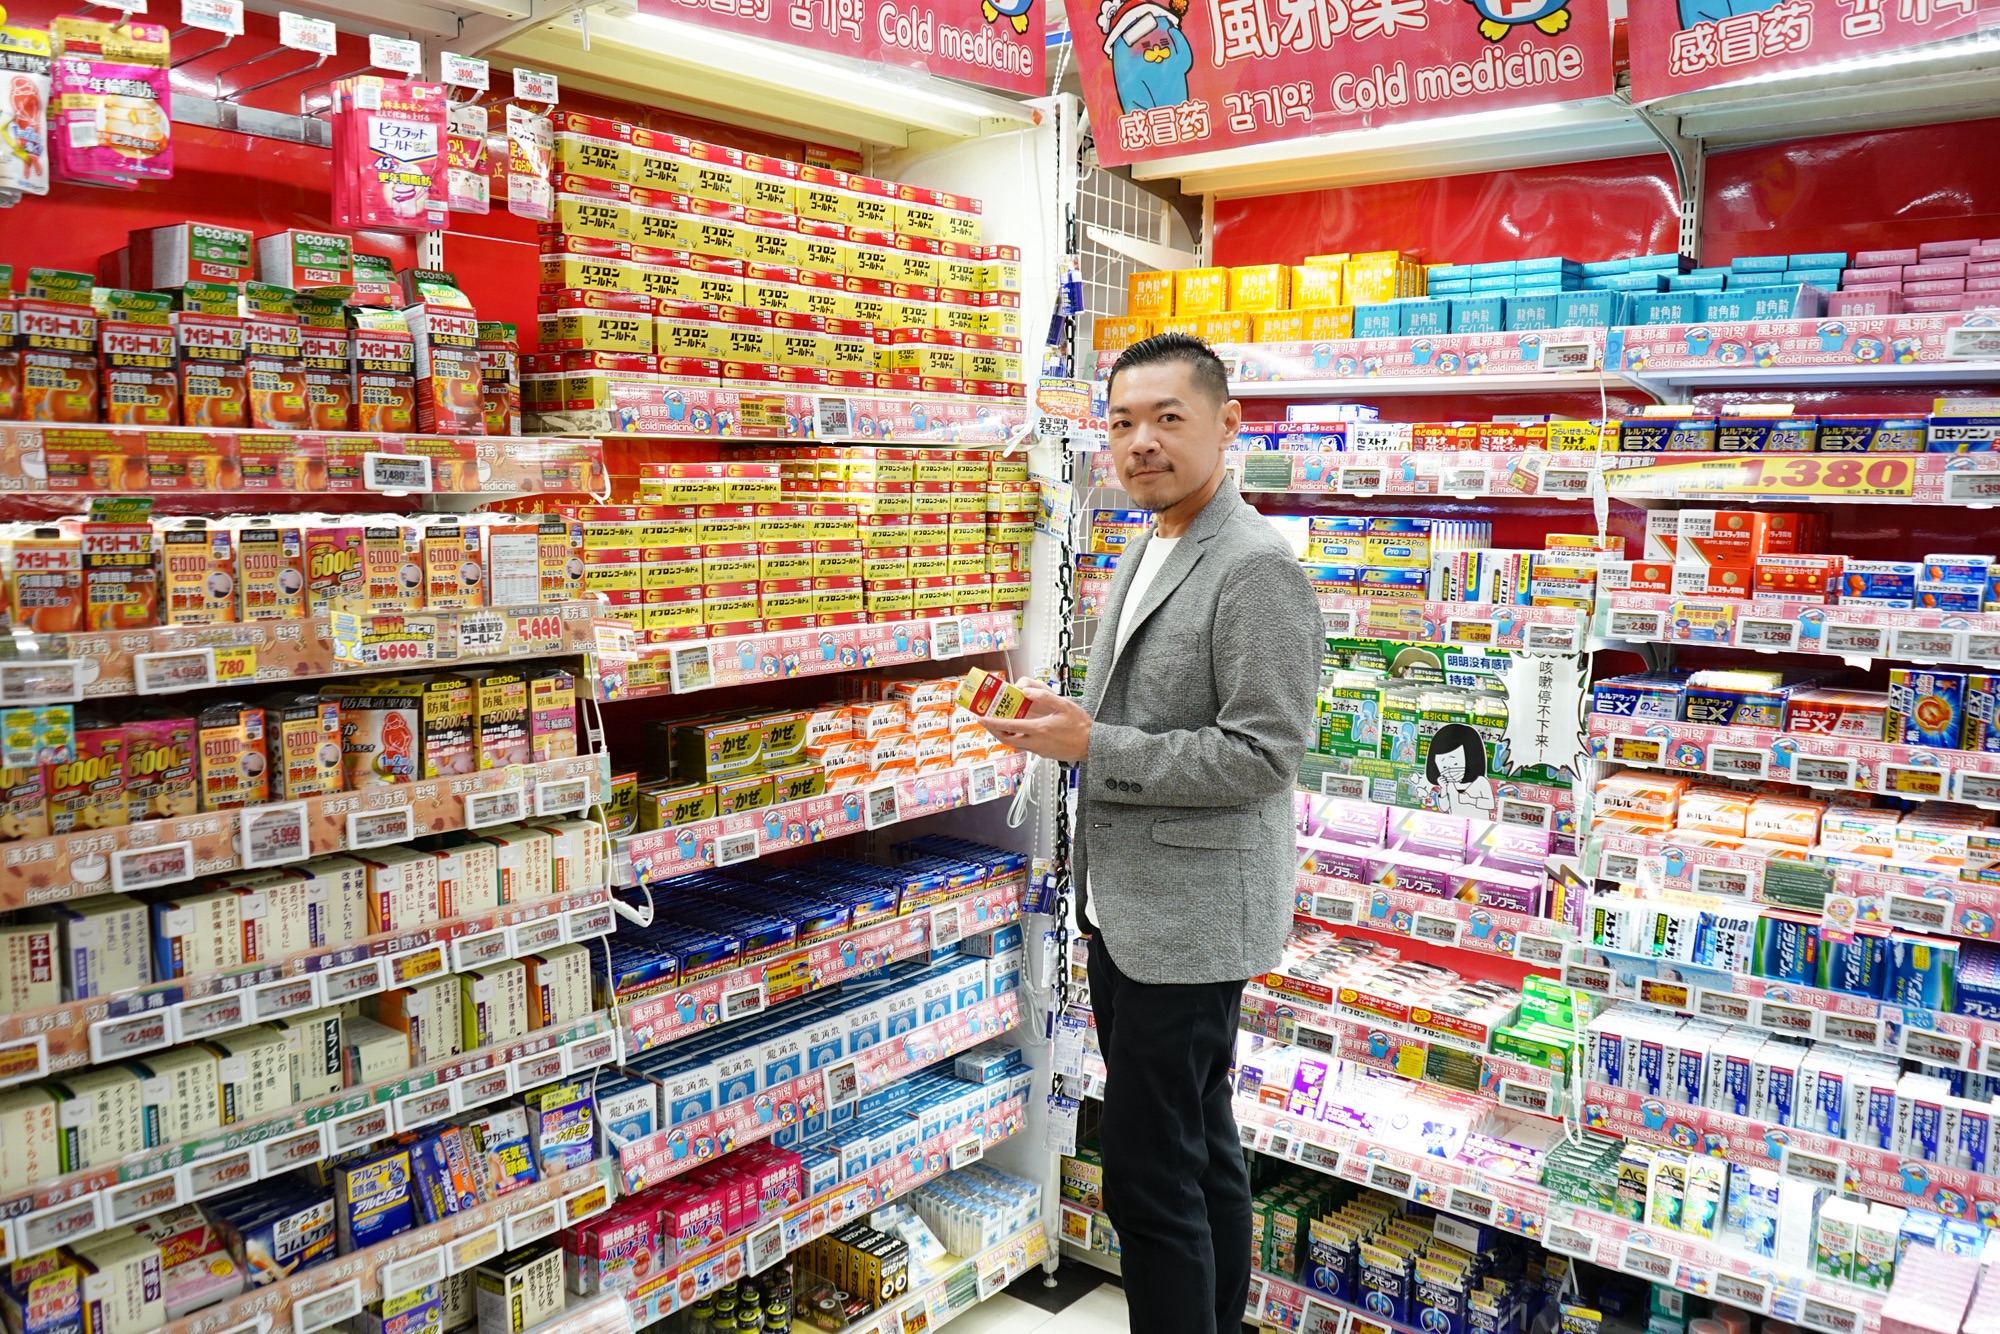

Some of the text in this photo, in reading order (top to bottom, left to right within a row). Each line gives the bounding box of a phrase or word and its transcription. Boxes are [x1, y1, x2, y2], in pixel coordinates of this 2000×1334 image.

[877, 4, 1034, 77] Cold medicine
[1669, 3, 1814, 77] 感冒药
[1331, 40, 1584, 114] Cold medicine
[1223, 81, 1315, 135] 감기약
[379, 122, 428, 140] ビスラット
[1118, 101, 1212, 151] 感冒药
[582, 158, 616, 171] ゴールドA
[643, 158, 680, 173] パブロン
[646, 169, 677, 183] ゴールドA
[809, 191, 839, 204] パブロン
[810, 202, 837, 214] ゴールドA
[580, 217, 616, 231] ゴールドA
[193, 226, 247, 244] ecoボトル
[295, 233, 346, 248] ecoボトル
[1568, 302, 1599, 318] 龍角散
[25, 314, 94, 337] ナイシトールZ
[430, 317, 475, 335] ナイシトールZ
[598, 319, 639, 332] パブロン
[1846, 319, 1886, 335] 감기약
[1896, 316, 1945, 332] 風邪薬
[184, 327, 242, 347] ナイシトールZ
[246, 323, 298, 345] ナイシトールZ
[600, 330, 636, 343] ゴールドA
[108, 334, 171, 354] ナイシトールZ
[1366, 340, 1398, 352] 風邪薬
[1563, 353, 1588, 363] 598
[1648, 355, 1720, 368] Cold medicine
[1078, 418, 1109, 431] 399
[1278, 423, 1335, 433] のどの痛みなどに
[1551, 428, 1597, 436] つらいせき、たん
[1424, 437, 1447, 446] ストナ
[1623, 435, 1663, 450] EX
[1719, 435, 1760, 450] EX
[1821, 435, 1865, 450] EX
[1358, 477, 1379, 486] 1,490
[1739, 459, 1908, 488] 1,380
[1310, 537, 1360, 546] パブロンエースPro
[1369, 538, 1425, 547] パブロンエースPro
[369, 584, 397, 599] 脂肪
[431, 582, 457, 598] 脂肪
[172, 593, 204, 612] 脂肪
[246, 590, 277, 607] 脂肪
[517, 614, 563, 642] 5,999
[1630, 620, 1658, 633] 2,490
[783, 636, 809, 649] 風邪薬
[1761, 629, 1792, 643] 1,290
[1849, 636, 1880, 648] 1,990
[753, 638, 777, 652] 감기약
[1920, 641, 1953, 652] 1,290
[1449, 674, 1476, 687] 持续
[1335, 689, 1361, 699] 長引く咳
[1535, 660, 1554, 762] 咳嗽停不下来!
[1596, 699, 1633, 714] EX
[1687, 706, 1729, 721] EX
[1791, 709, 1837, 720] ルルアタック
[771, 723, 796, 741] かぜの
[1839, 718, 1865, 731] 発熱
[722, 734, 751, 754] かぜの
[207, 776, 238, 794] 脂肪
[789, 778, 816, 797] かぜの
[1341, 785, 1363, 795] 900
[808, 800, 833, 814] 風邪薬
[880, 800, 896, 813] 2,490
[652, 858, 706, 877] Cold medicine
[1317, 861, 1360, 881] アレグラFX
[1396, 876, 1442, 897] アレグラFX
[1719, 879, 1745, 892] 1,790
[560, 893, 603, 911] 鼻づまり
[1478, 892, 1528, 913] アレグラFX
[1953, 888, 1995, 907] 감기약
[587, 914, 610, 928] 1,850
[1912, 911, 1944, 925] 2,480
[373, 933, 427, 955] 二日酔い
[1460, 936, 1497, 951] medicine
[31, 934, 50, 982] 五十肩
[319, 951, 354, 969] 便秘
[995, 959, 1019, 974] 龍角散
[1584, 975, 1609, 989] 889
[127, 994, 165, 1013] 頭痛
[850, 1011, 879, 1028] 龍角散
[654, 1021, 706, 1046] Cold medicine
[809, 1025, 841, 1044] 龍角散
[1344, 1038, 1370, 1053] 感冒药
[445, 1061, 487, 1082] 生理痛
[671, 1078, 710, 1096] 龍角散
[840, 1077, 856, 1091] 2,190
[1522, 1094, 1547, 1108] 1,190
[555, 1122, 591, 1143] ナイトミン
[499, 1145, 522, 1163] 天気
[350, 1160, 400, 1185] アルコール
[1066, 1160, 1098, 1177] ちくのう症
[1622, 1167, 1645, 1182] AG
[1661, 1165, 1684, 1180] AG
[1928, 1164, 1969, 1187] 감기약
[1066, 1178, 1096, 1191] チクナイン
[1386, 1175, 1410, 1190] 1,290
[1863, 1168, 1904, 1189] 感冒药
[50, 1175, 108, 1203] めまい
[764, 1178, 797, 1198] ハレナース
[353, 1184, 408, 1216] アルピタン
[1467, 1202, 1491, 1216] 1,490
[683, 1214, 721, 1239] ハレナース
[277, 1222, 334, 1259] コムレケア
[605, 1235, 649, 1261] ハレナース
[1312, 1244, 1346, 1267] ダスモック
[1364, 1267, 1401, 1291] ダスモック
[1419, 1285, 1458, 1307] ダスモック
